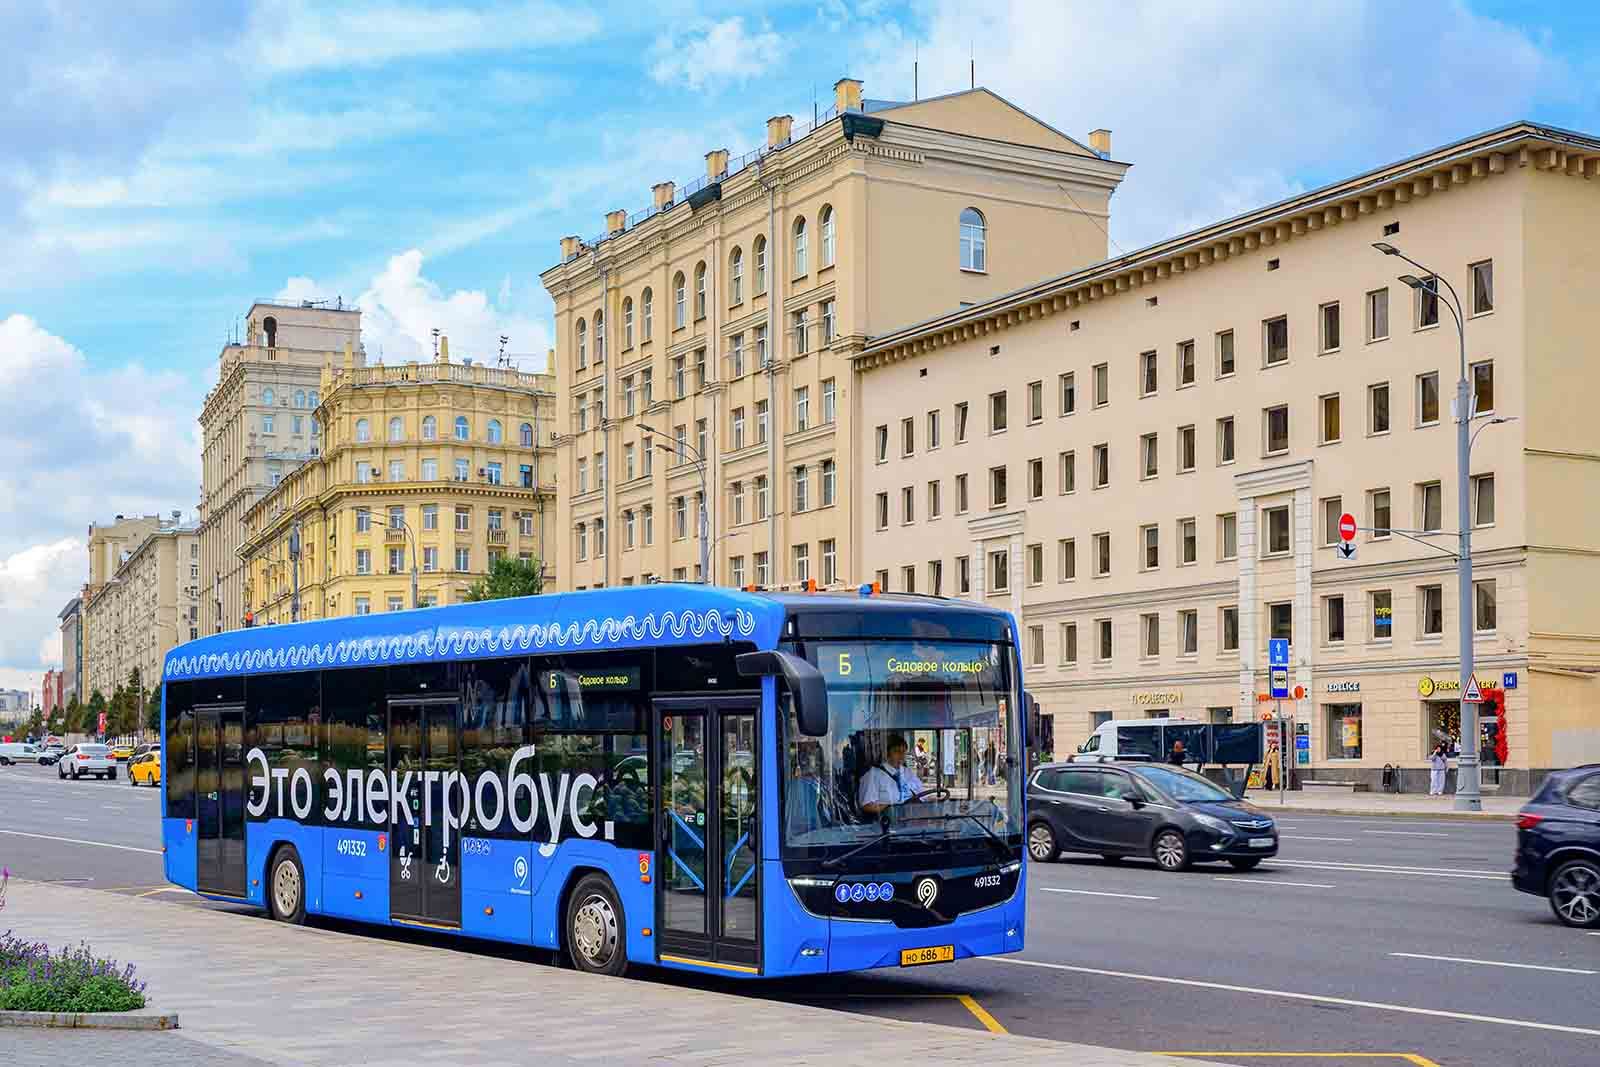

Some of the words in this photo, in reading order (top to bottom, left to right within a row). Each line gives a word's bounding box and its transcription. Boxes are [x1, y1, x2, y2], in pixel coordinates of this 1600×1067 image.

[838, 653, 852, 676] Б
[887, 658, 938, 673] Садовое
[942, 662, 983, 675] кольцо
[549, 673, 557, 689] Б
[578, 675, 604, 686] Садовое
[605, 675, 629, 685] кольцо
[1434, 679, 1460, 690] FRENC
[1504, 676, 1513, 685] 14
[246, 747, 313, 819] Это
[323, 744, 615, 857] электробус.
[336, 839, 367, 857] 491332
[974, 875, 1001, 888] 491332
[920, 949, 938, 961] 686
